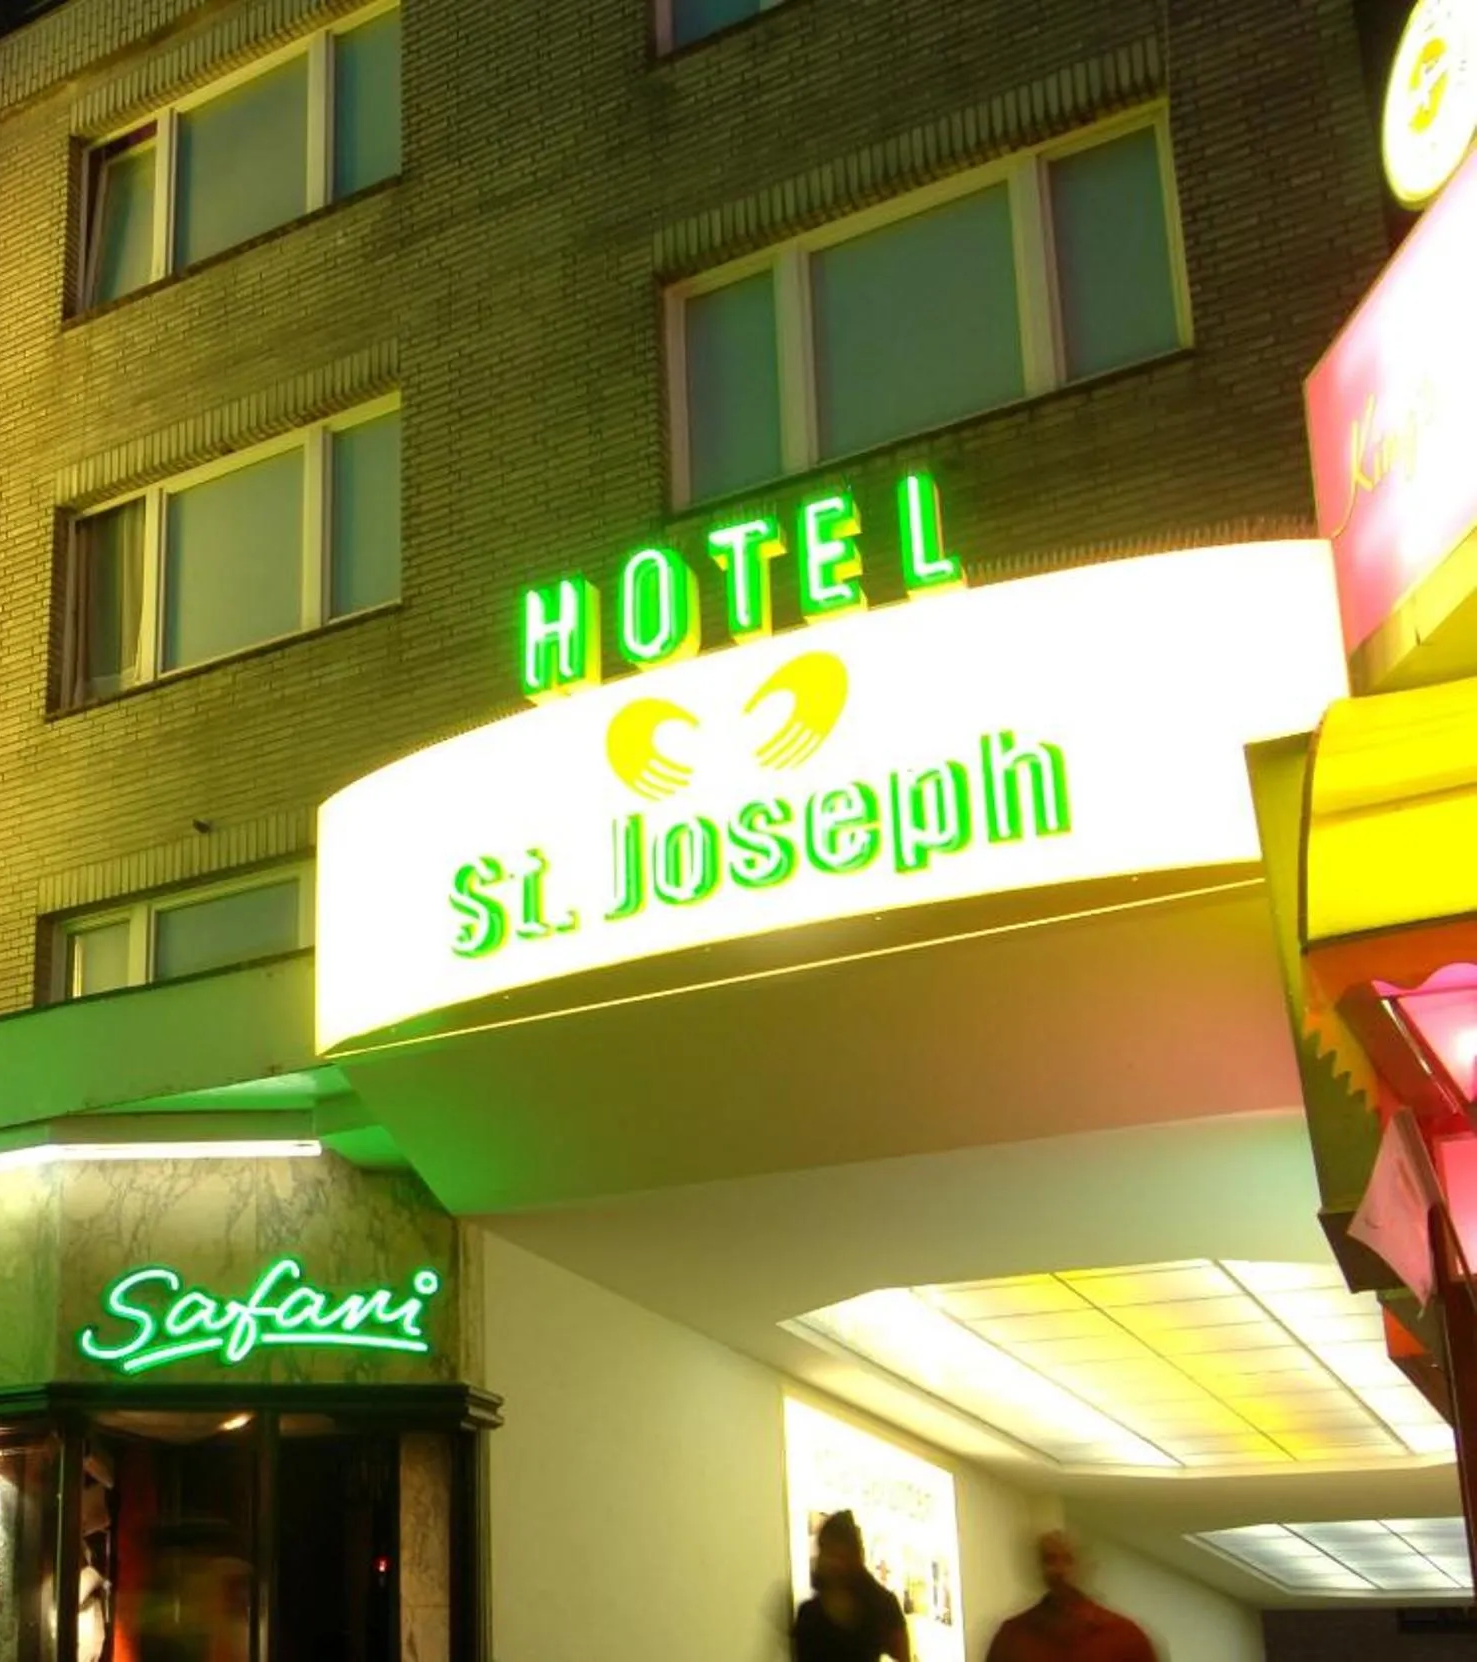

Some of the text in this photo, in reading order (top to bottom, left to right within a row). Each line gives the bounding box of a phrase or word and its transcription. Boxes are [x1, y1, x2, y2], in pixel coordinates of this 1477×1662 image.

[523, 470, 967, 704] HOTEL
[604, 731, 1072, 919] Joseph
[82, 1259, 438, 1371] Safari
